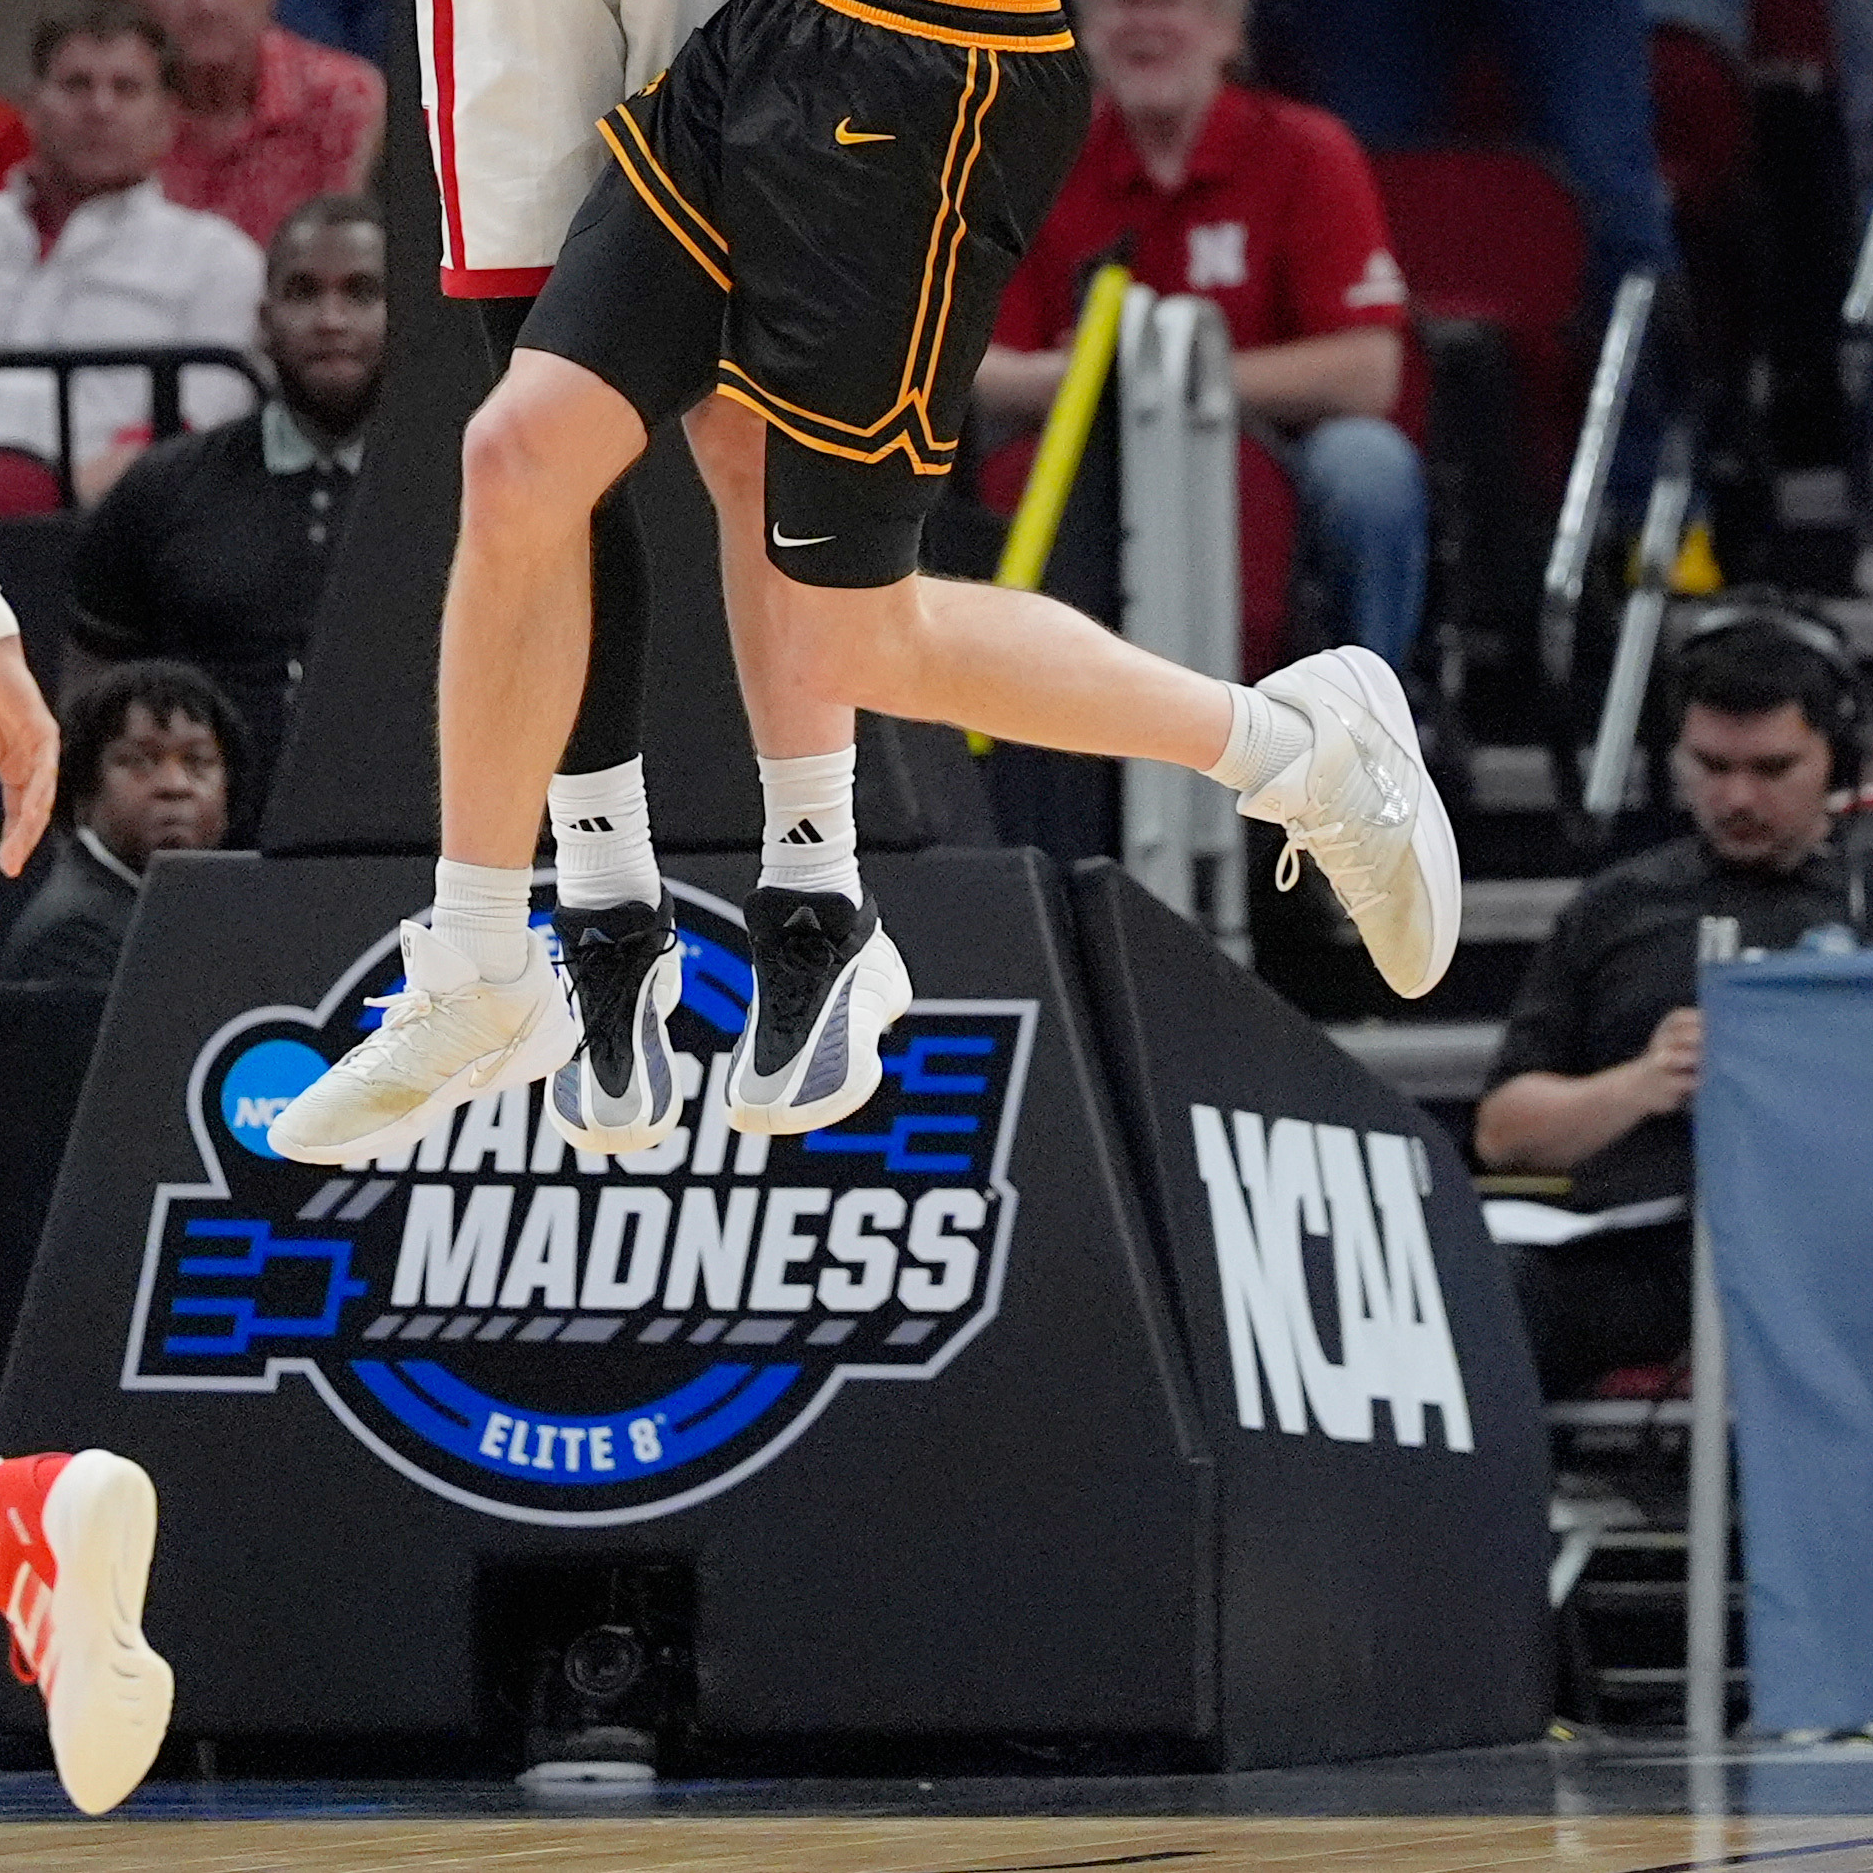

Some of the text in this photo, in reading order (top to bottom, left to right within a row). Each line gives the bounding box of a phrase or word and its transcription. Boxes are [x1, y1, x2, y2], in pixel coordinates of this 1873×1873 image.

[390, 1184, 988, 1313] MADNESS
[1190, 1102, 1475, 1455] NCAA
[478, 1411, 664, 1472] ELITE 8
